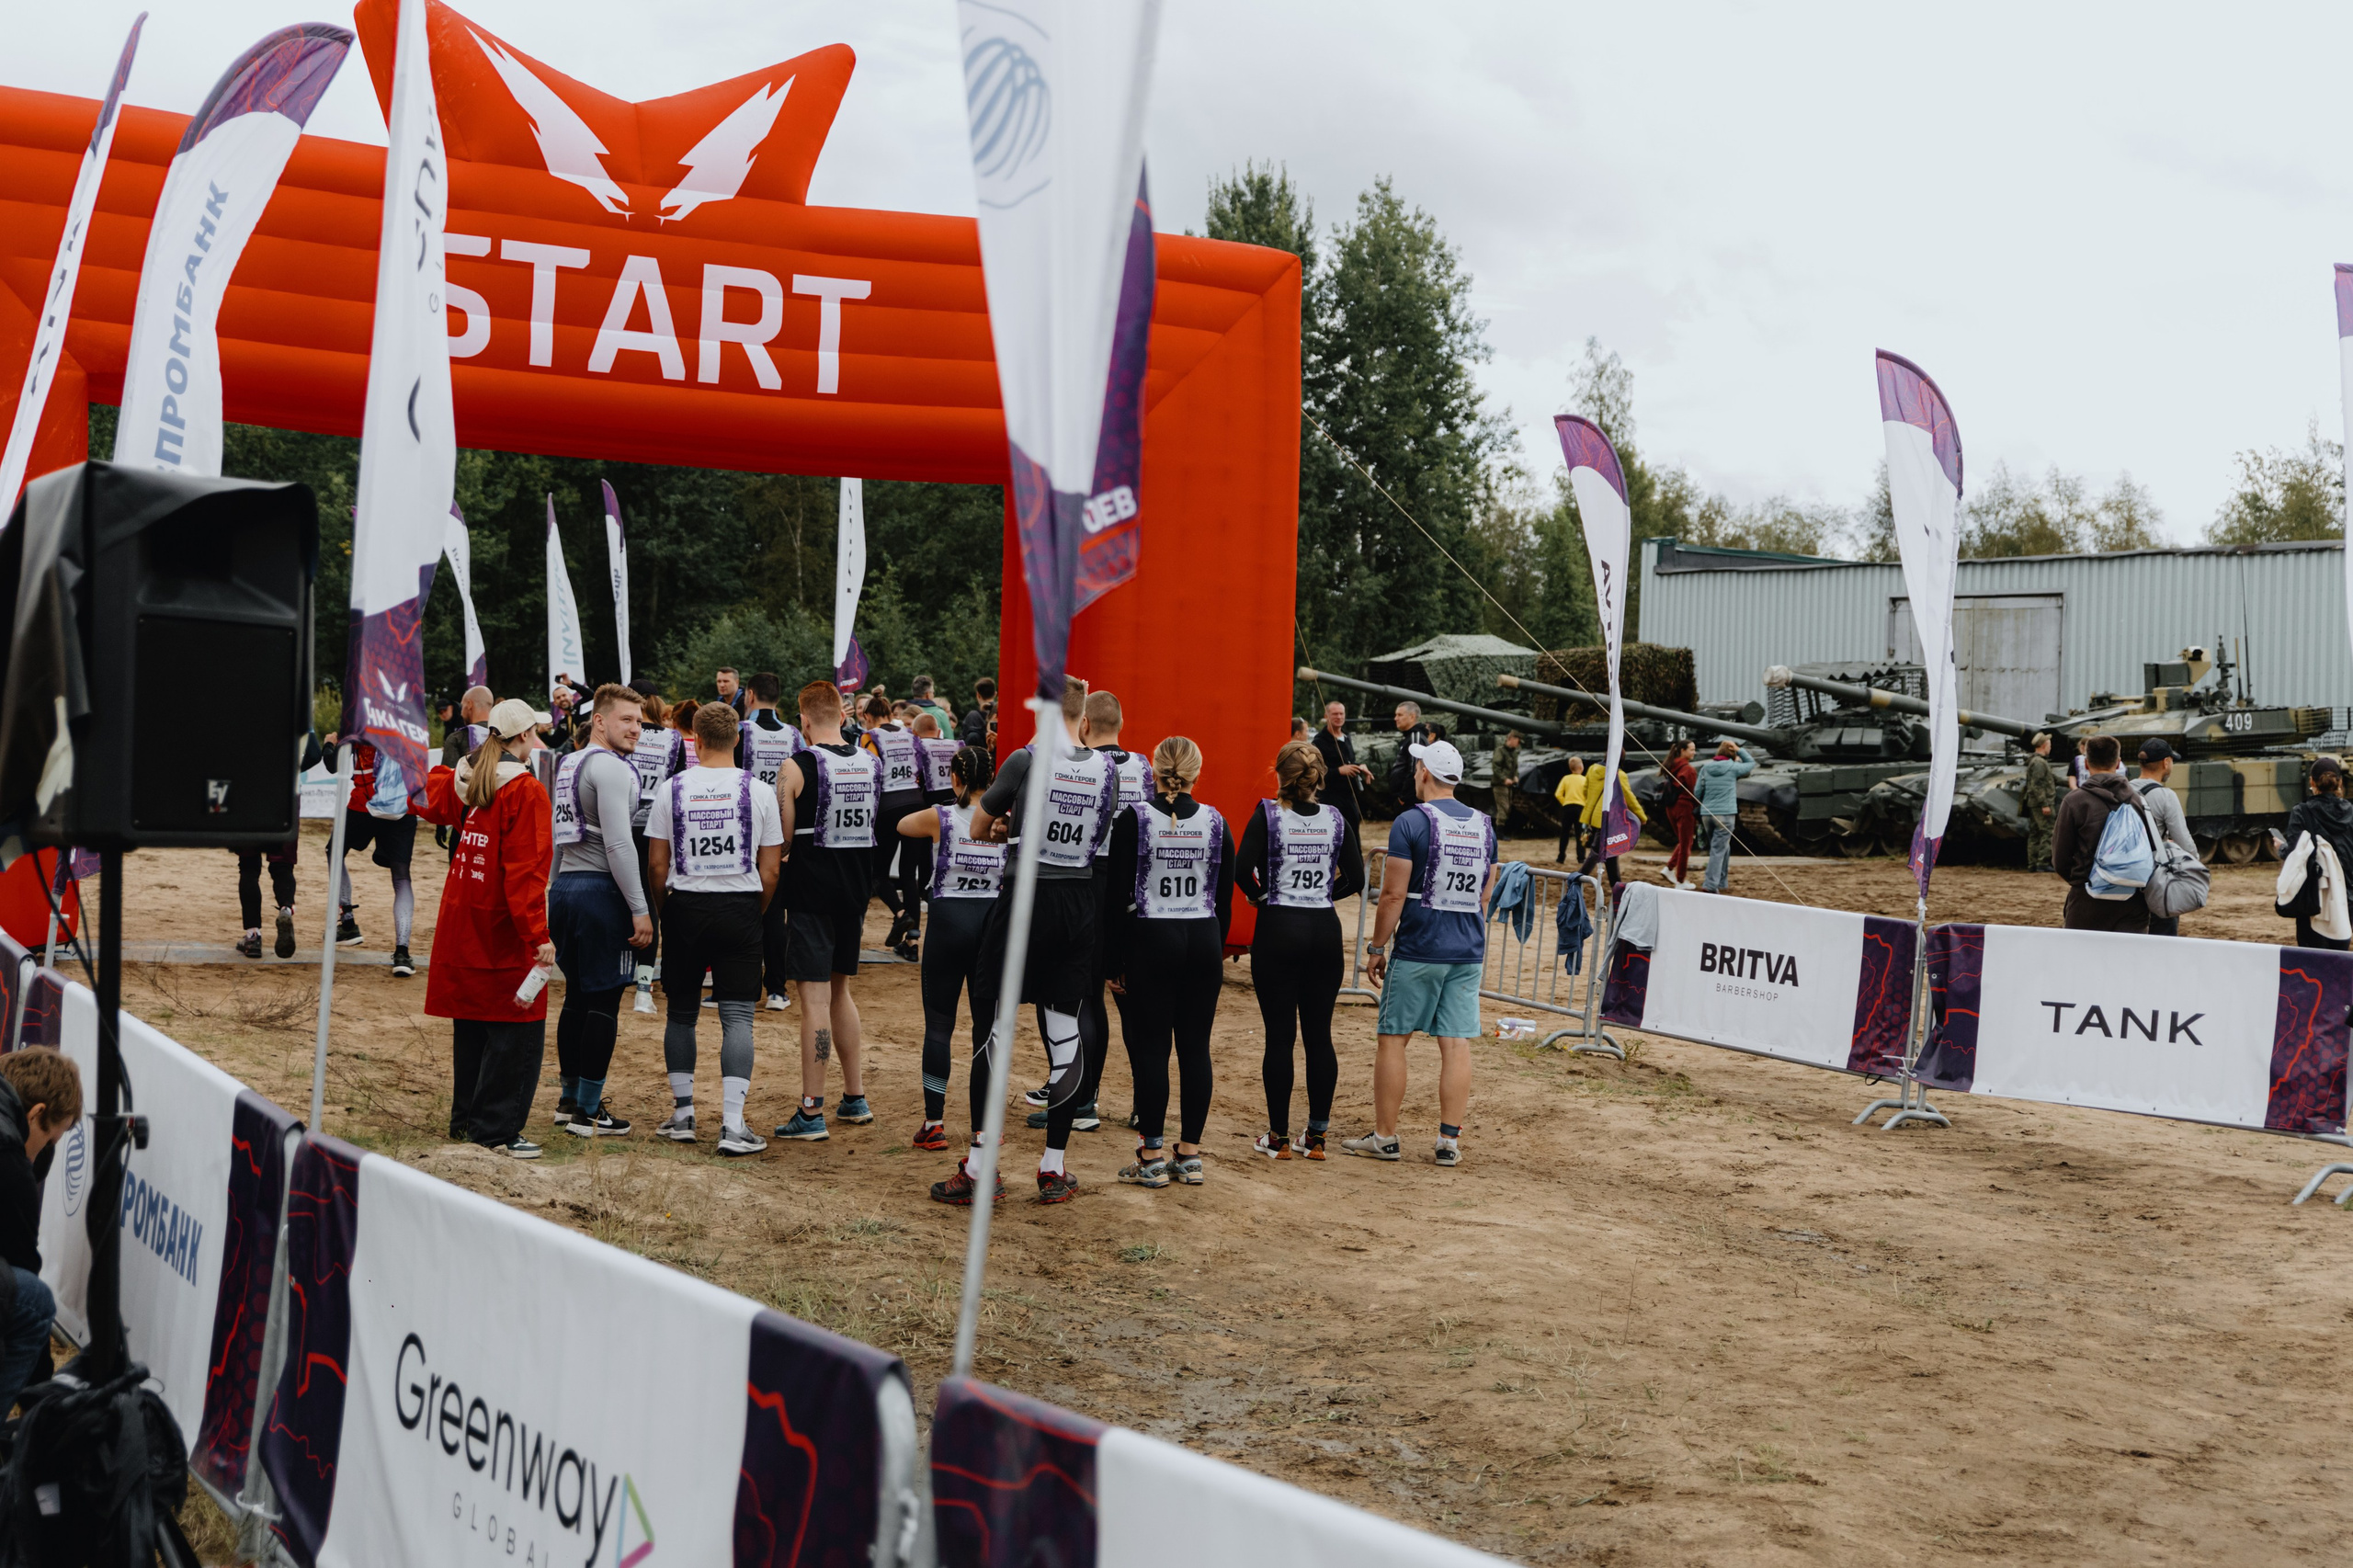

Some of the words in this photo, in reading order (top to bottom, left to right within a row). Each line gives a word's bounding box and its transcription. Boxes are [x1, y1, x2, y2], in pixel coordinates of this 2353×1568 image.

[443, 232, 872, 394] START
[1082, 483, 1137, 534] ОЕВ
[2225, 712, 2252, 731] 409
[639, 762, 656, 770] СТАРТ
[892, 766, 913, 778] 846
[938, 766, 951, 778] 87
[759, 771, 777, 785] 82
[1055, 772, 1074, 780] ГОНКА
[1074, 775, 1097, 783] ГЕРОЕВ
[836, 782, 870, 792] МАССОВЫЙ
[846, 793, 864, 801] СТАРТ
[1051, 791, 1095, 807] МАССОВЫЙ
[690, 809, 733, 820] МАССОВЫЙ
[1060, 803, 1083, 815] СТАРТ
[700, 820, 722, 829] СТАРТ
[835, 809, 870, 828] 1551
[1047, 821, 1084, 846] 604
[1607, 833, 1628, 846] ЕРОЕВ
[689, 835, 735, 857] 1254
[1158, 847, 1203, 858] МАССОВЫЙ
[1289, 844, 1329, 854] МАССОВЫЙ
[1446, 846, 1481, 858] МАССОВЫЙ
[957, 854, 998, 867] МАССОВЫЙ
[1050, 851, 1080, 860] ГАЗПРОМБАНК
[1299, 854, 1320, 862] СТАРТ
[1453, 857, 1472, 866] СТАРТ
[966, 865, 989, 874] СТАРТ
[1168, 859, 1191, 869] СТАРТ
[1291, 869, 1324, 890] 792
[1446, 871, 1477, 893] 732
[1160, 876, 1197, 898] 610
[1699, 942, 1799, 987] BRITVA
[1716, 983, 1779, 1002] BARBERSHOP
[2040, 1000, 2206, 1046] TANK
[120, 1169, 203, 1287] РОМБАНК
[395, 1332, 618, 1568] Greenway
